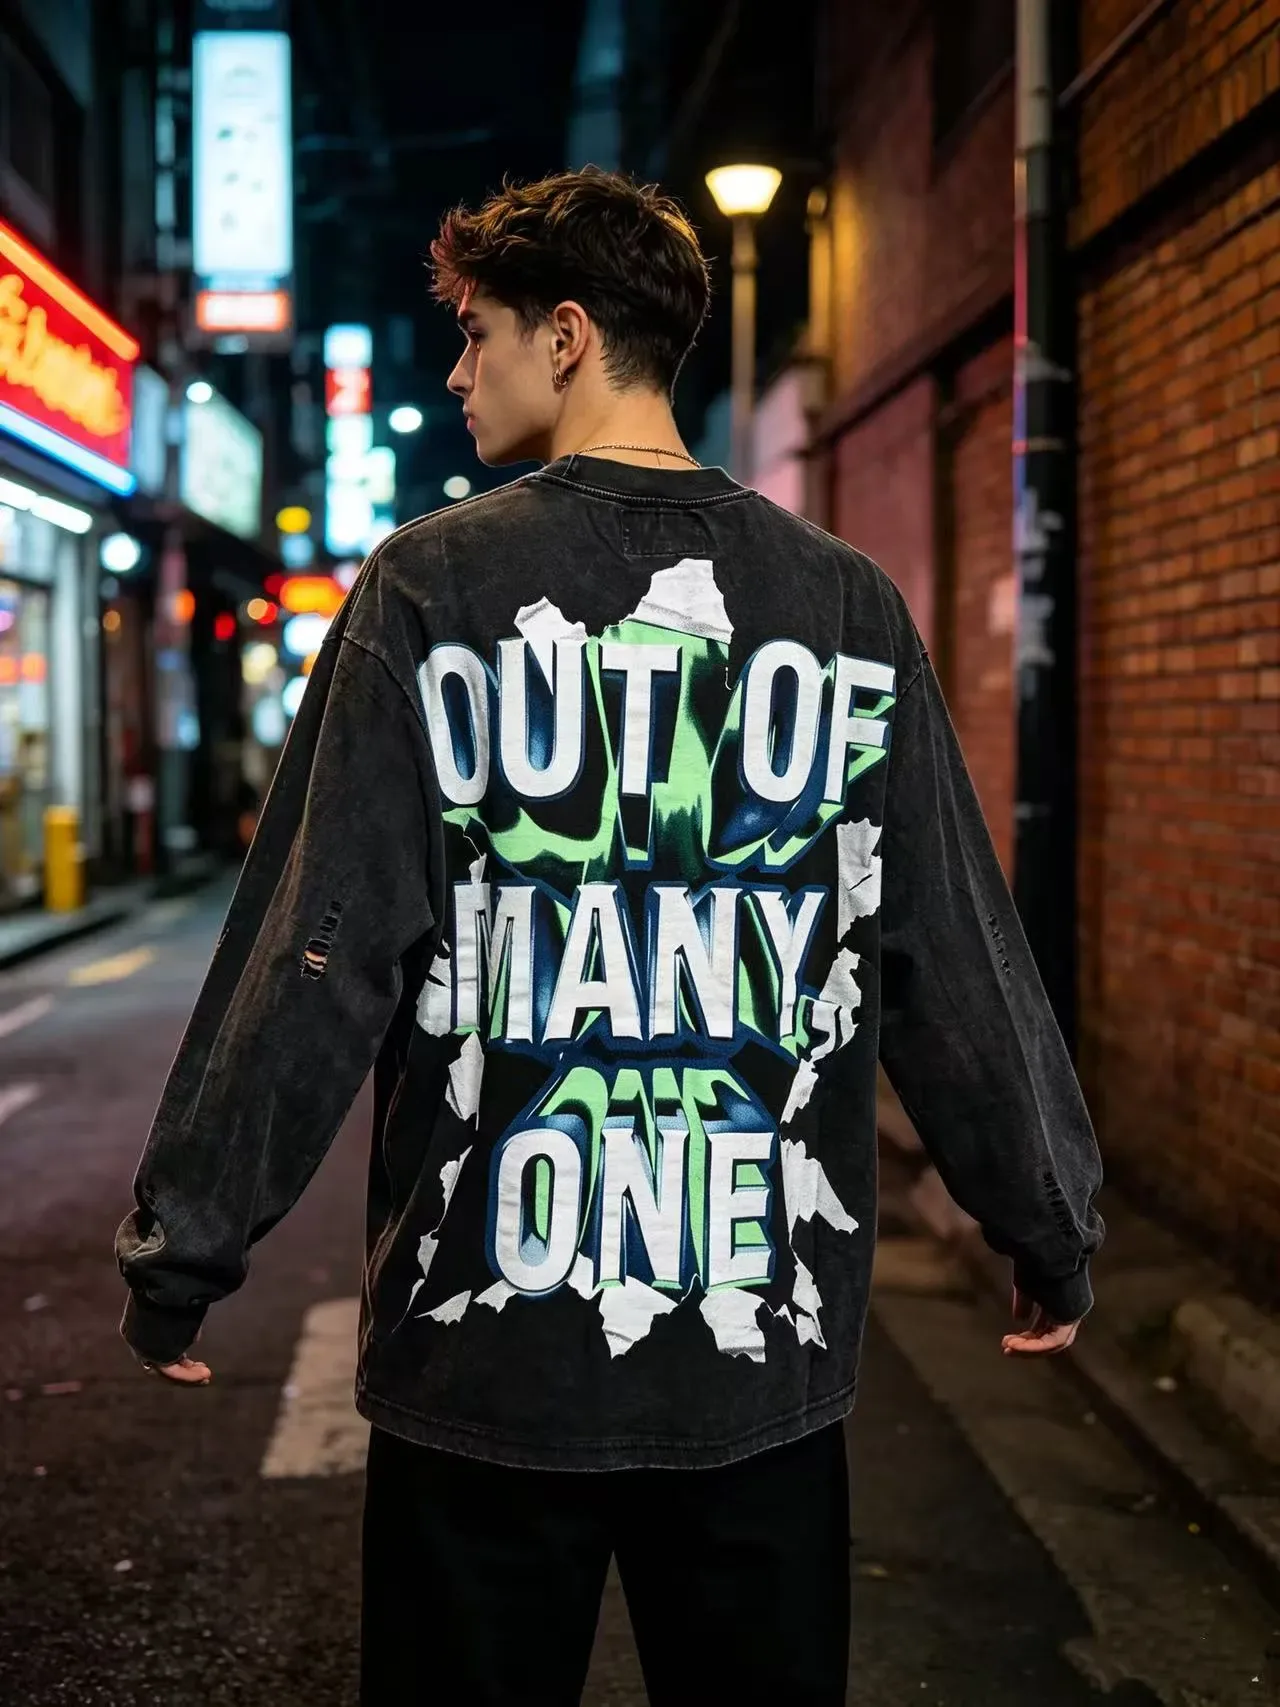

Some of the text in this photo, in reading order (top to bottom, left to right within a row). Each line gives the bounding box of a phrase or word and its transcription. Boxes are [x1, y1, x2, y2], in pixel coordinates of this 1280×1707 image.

[419, 640, 896, 804] OUT OF
[453, 884, 826, 1044] MANY
[494, 1127, 775, 1295] ONE
